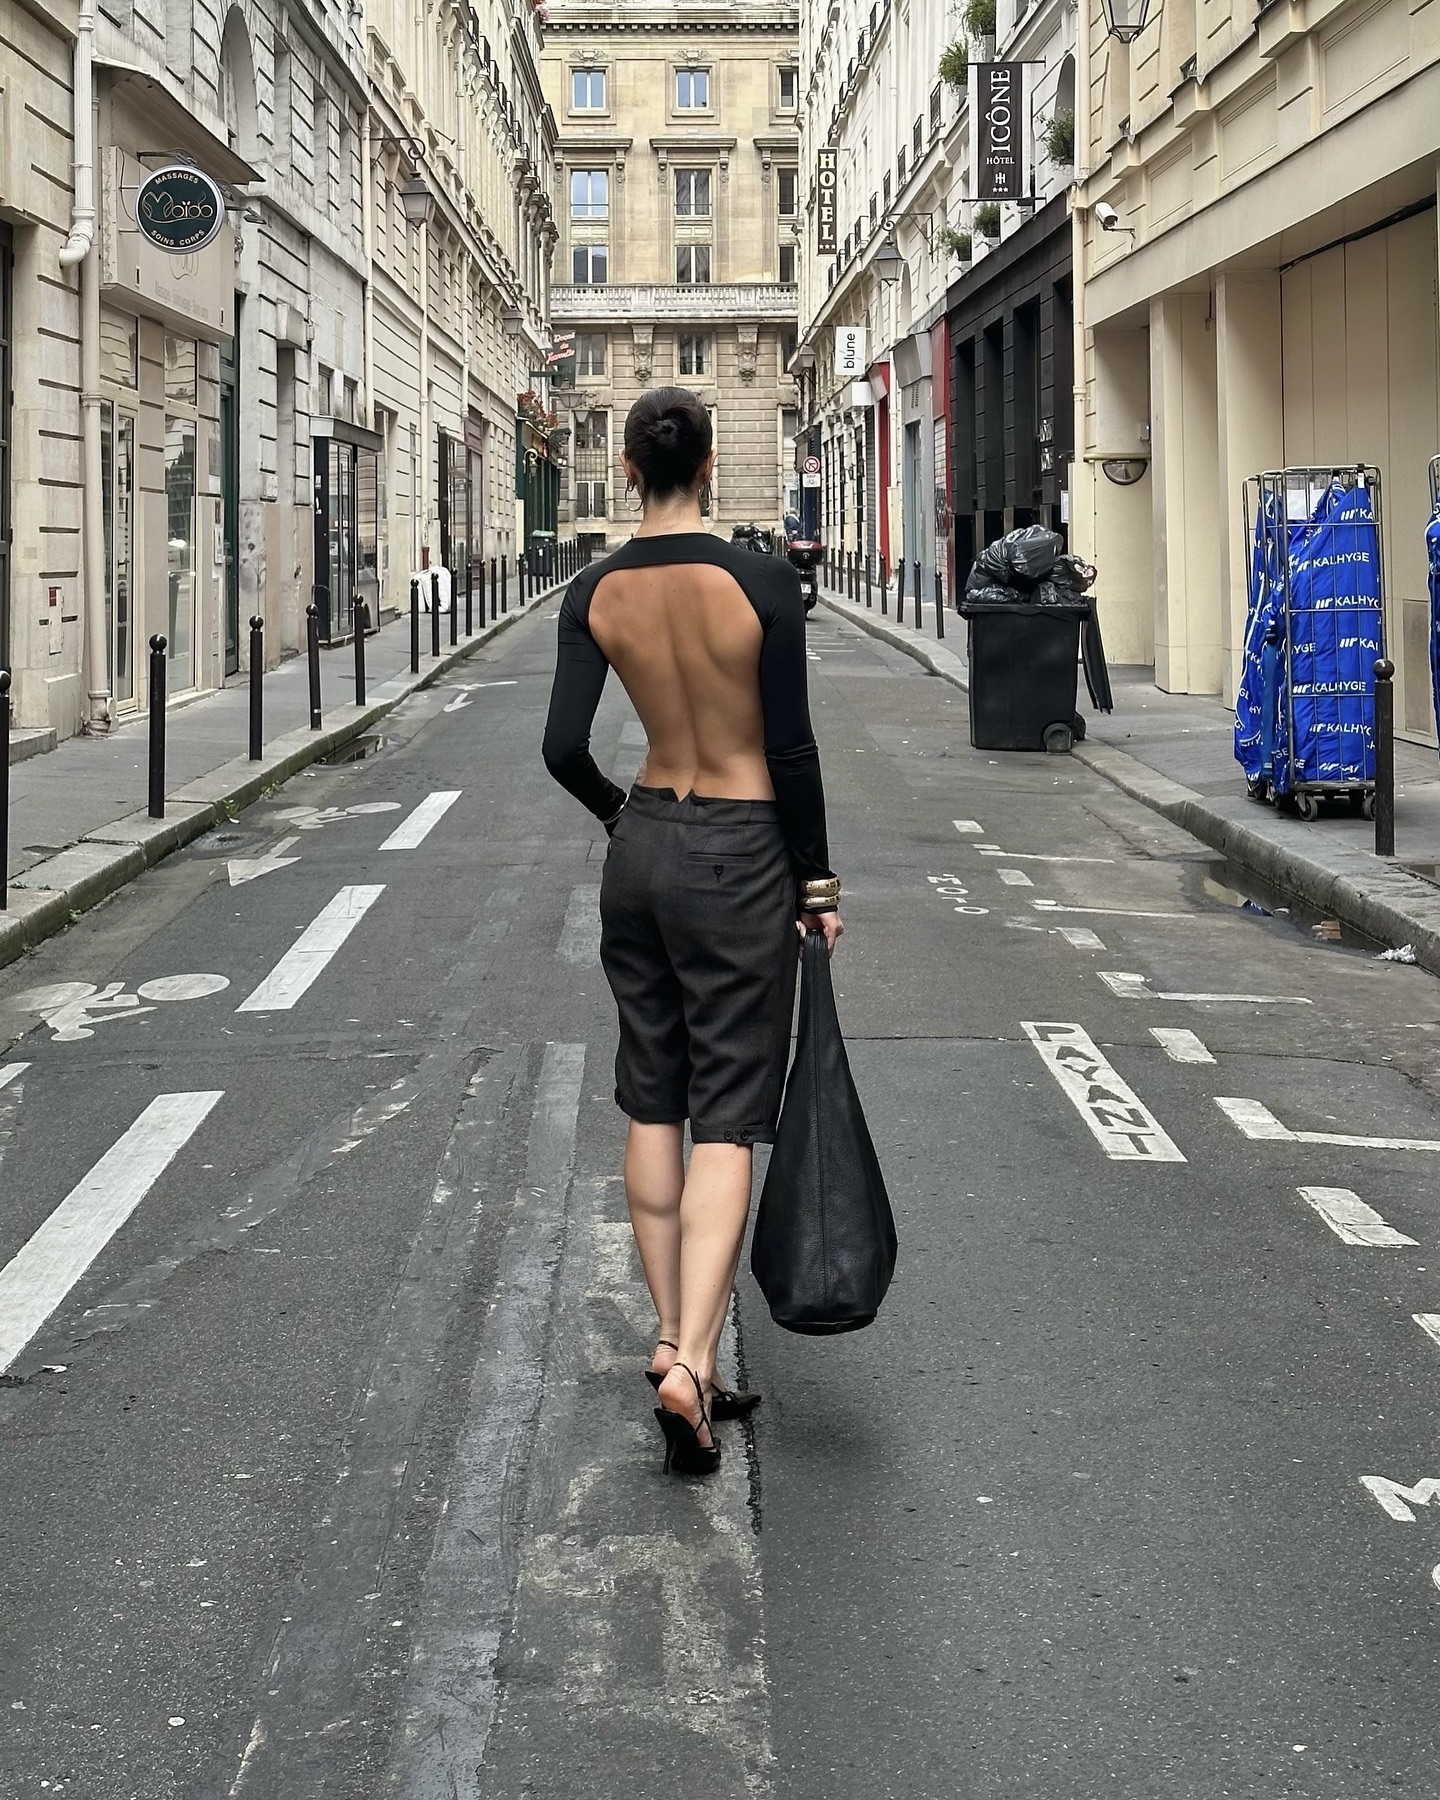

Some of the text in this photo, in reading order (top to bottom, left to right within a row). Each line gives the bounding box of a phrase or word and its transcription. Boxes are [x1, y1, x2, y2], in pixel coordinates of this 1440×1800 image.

[985, 69, 1011, 153] ICÔNE
[986, 155, 1016, 165] HÔTEL
[154, 172, 199, 185] MASSAGES
[819, 153, 836, 240] HOTEL
[151, 229, 205, 246] SOINS CORPS
[1313, 551, 1370, 569] KALHYGE
[1312, 680, 1367, 693] KALHYGE
[926, 873, 990, 915] MOTO
[1033, 1025, 1156, 1155] PAYANT
